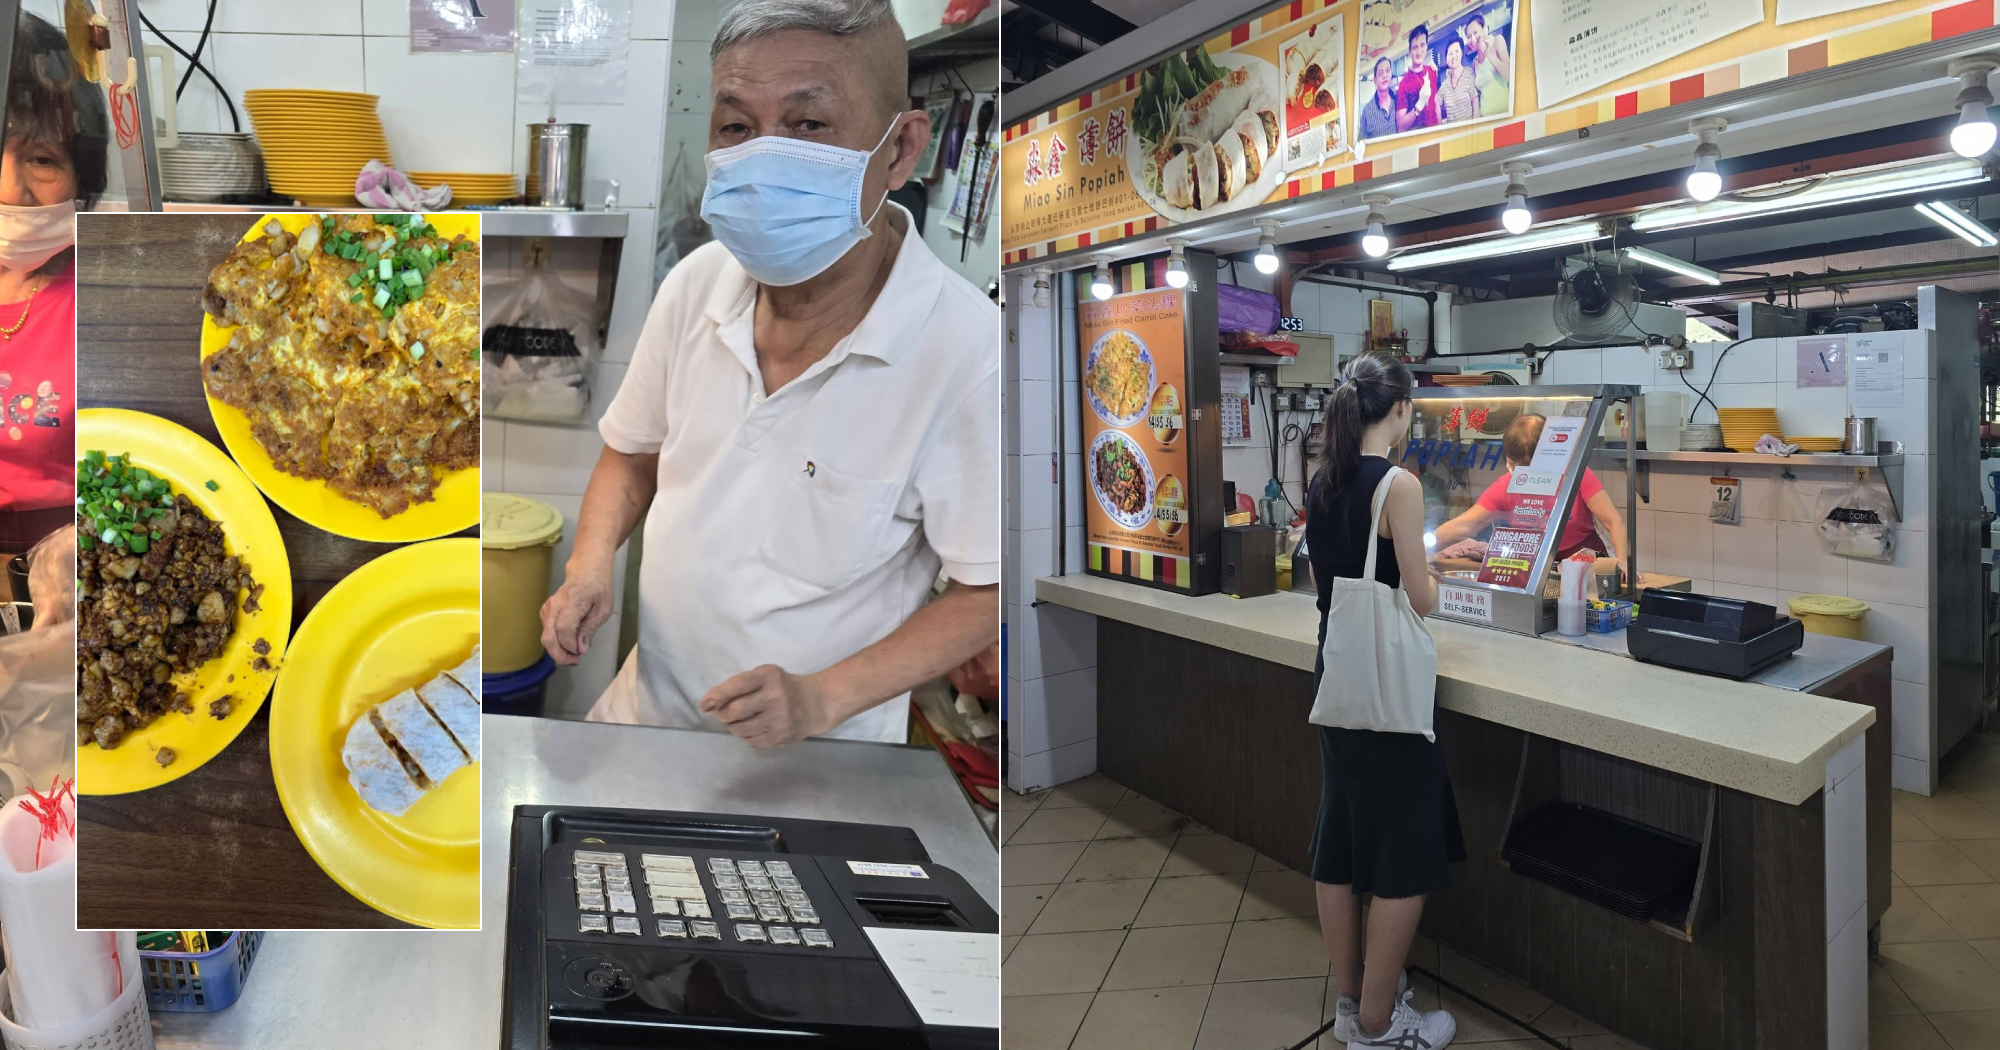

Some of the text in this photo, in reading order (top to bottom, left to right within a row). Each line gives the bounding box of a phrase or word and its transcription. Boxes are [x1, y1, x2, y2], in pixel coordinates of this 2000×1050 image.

[1078, 109, 1127, 164] 薄餅
[1024, 165, 1125, 211] Miao Sin Popiah
[1103, 208, 1116, 218] Food
[1117, 203, 1136, 214] market
[1102, 319, 1113, 327] Sin
[1115, 317, 1133, 325] Fried
[1134, 315, 1157, 323] Carrot
[1158, 312, 1178, 320] Cake
[1401, 437, 1504, 472] POPIAH
[1717, 486, 1733, 501] 12
[1494, 530, 1542, 543] SINGAPORE
[1511, 543, 1535, 553] FOODS
[1446, 590, 1484, 606] 自助服務
[1444, 602, 1486, 617] SELF-SERVICE
